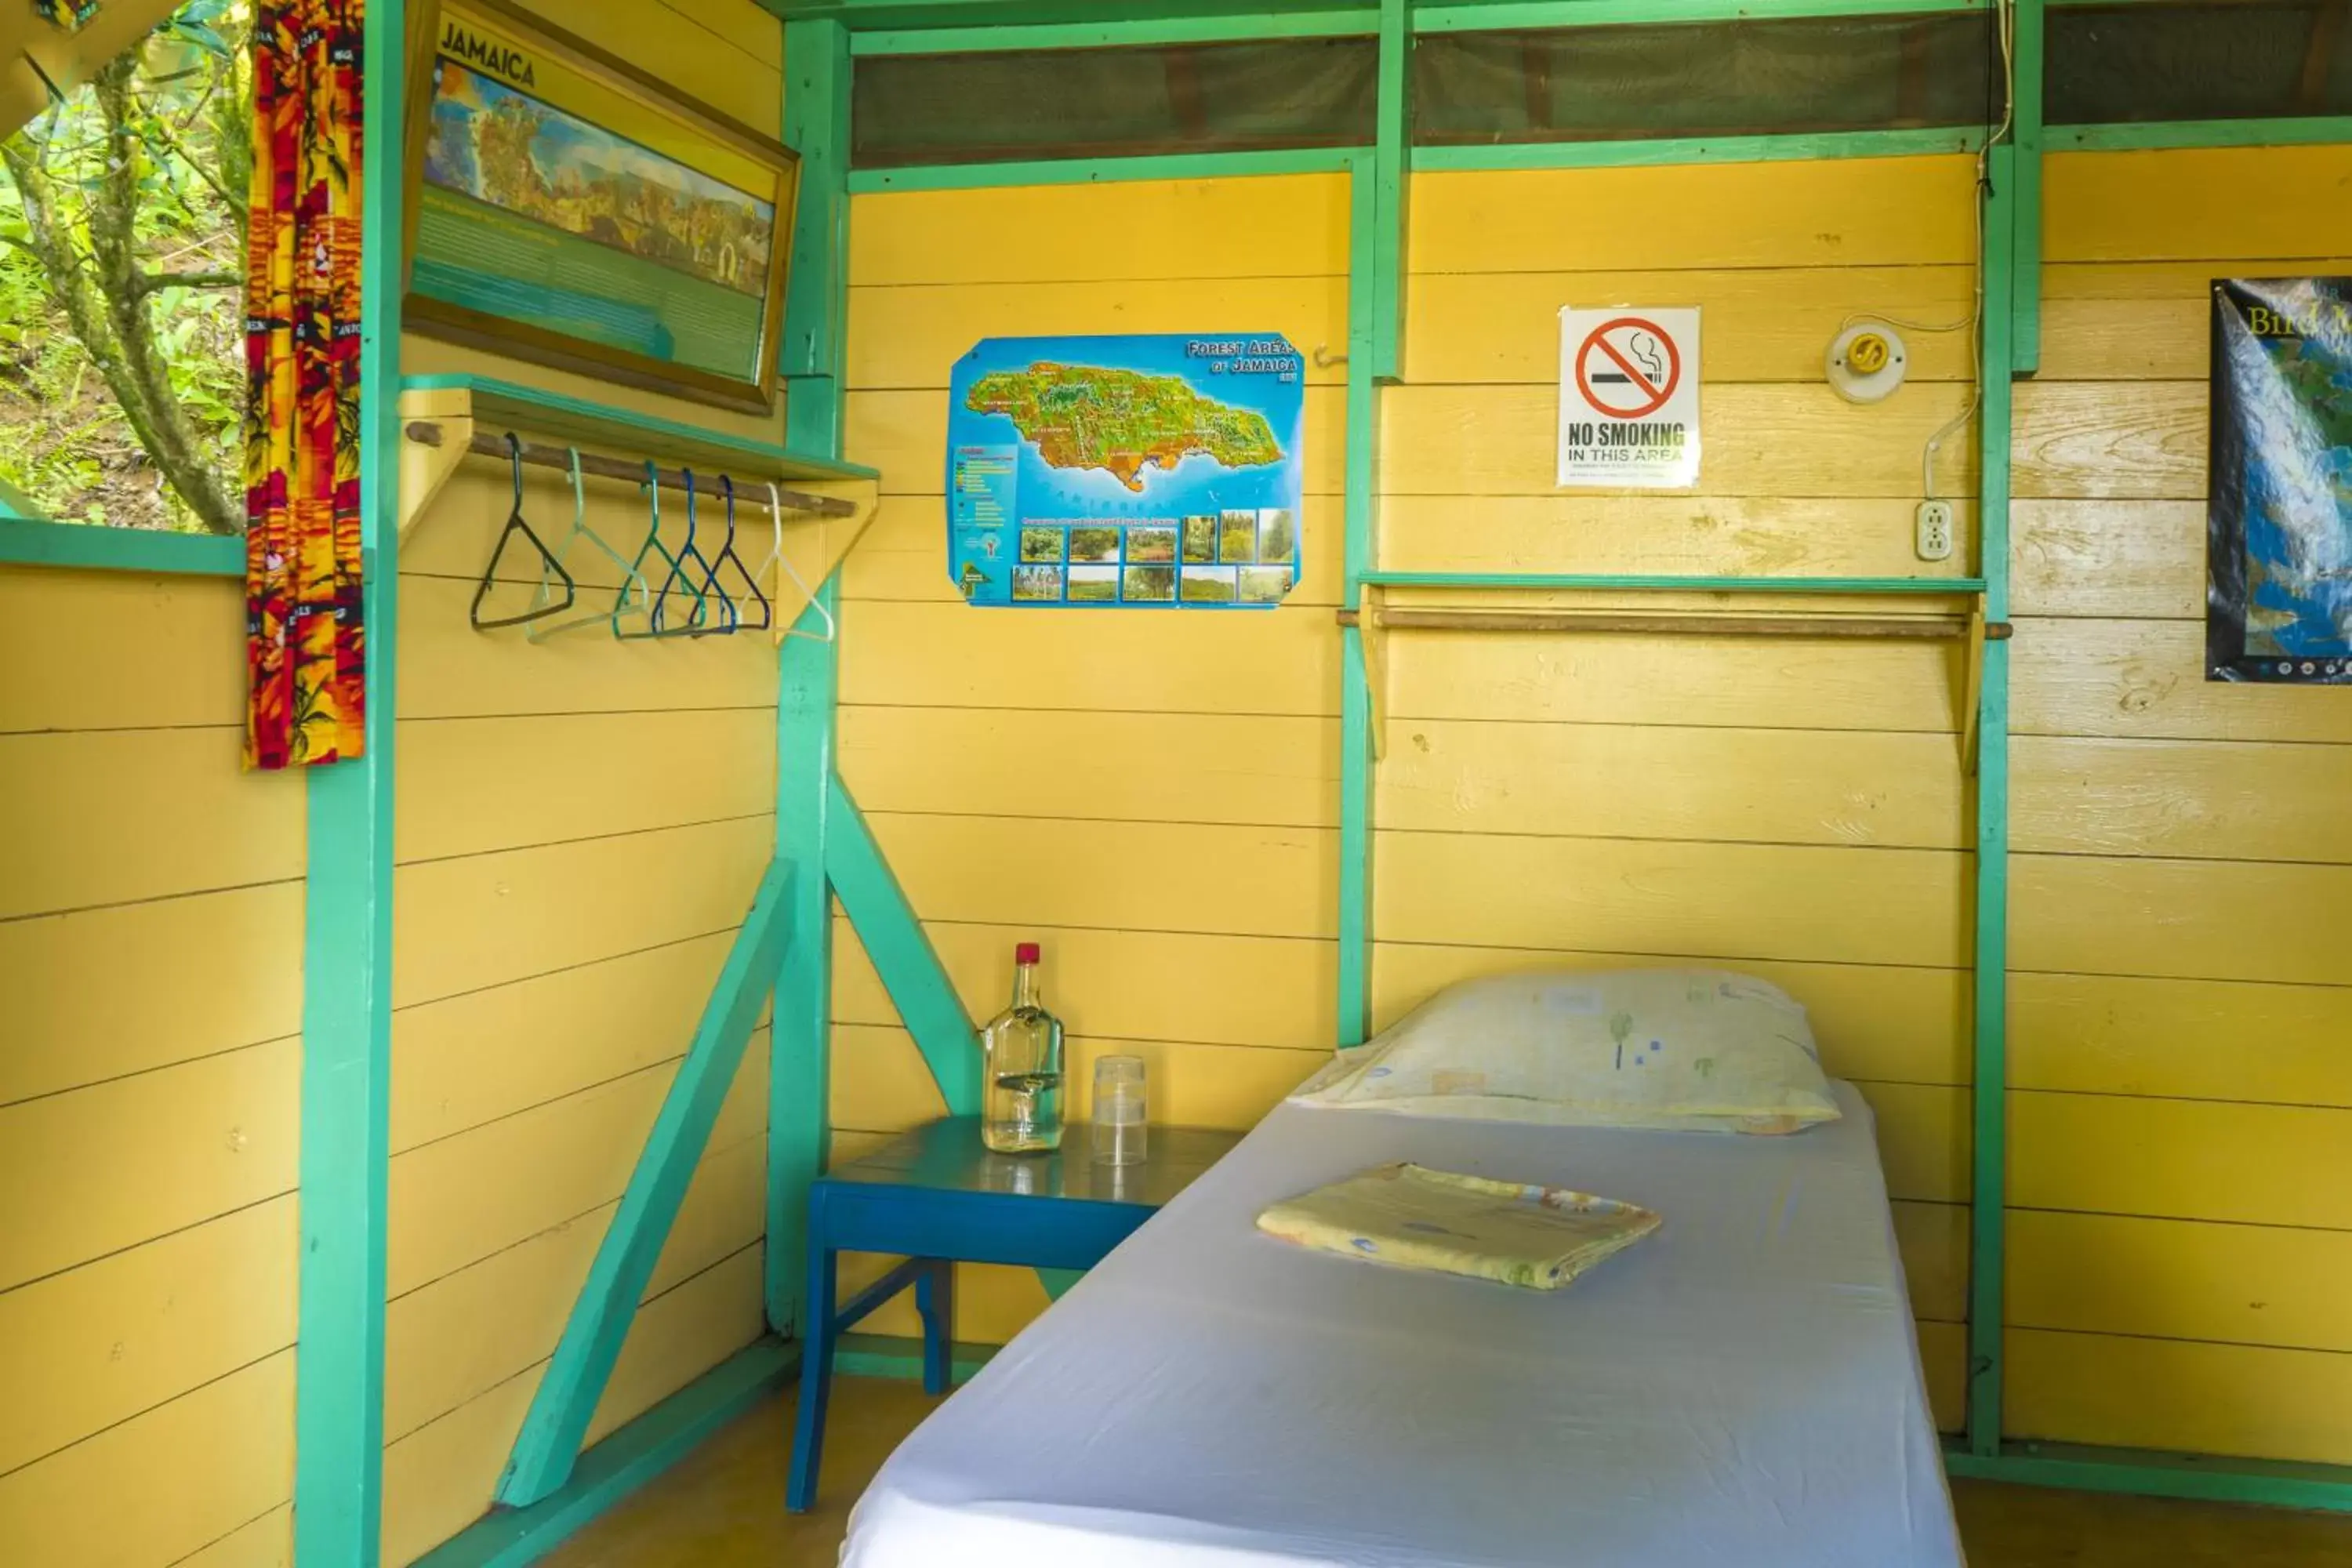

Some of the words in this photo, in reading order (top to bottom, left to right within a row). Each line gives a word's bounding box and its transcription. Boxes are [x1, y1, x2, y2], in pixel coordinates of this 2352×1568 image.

[441, 22, 535, 89] JAMAICA
[2247, 301, 2318, 335] Bird
[1188, 340, 1245, 355] FOREST
[1232, 358, 1298, 372] JAMAICA
[1568, 423, 1593, 446] NO
[1598, 423, 1685, 446] SMOKING
[1568, 449, 1584, 461] IN
[1591, 449, 1629, 462] THIS
[1634, 449, 1682, 461] AREA
